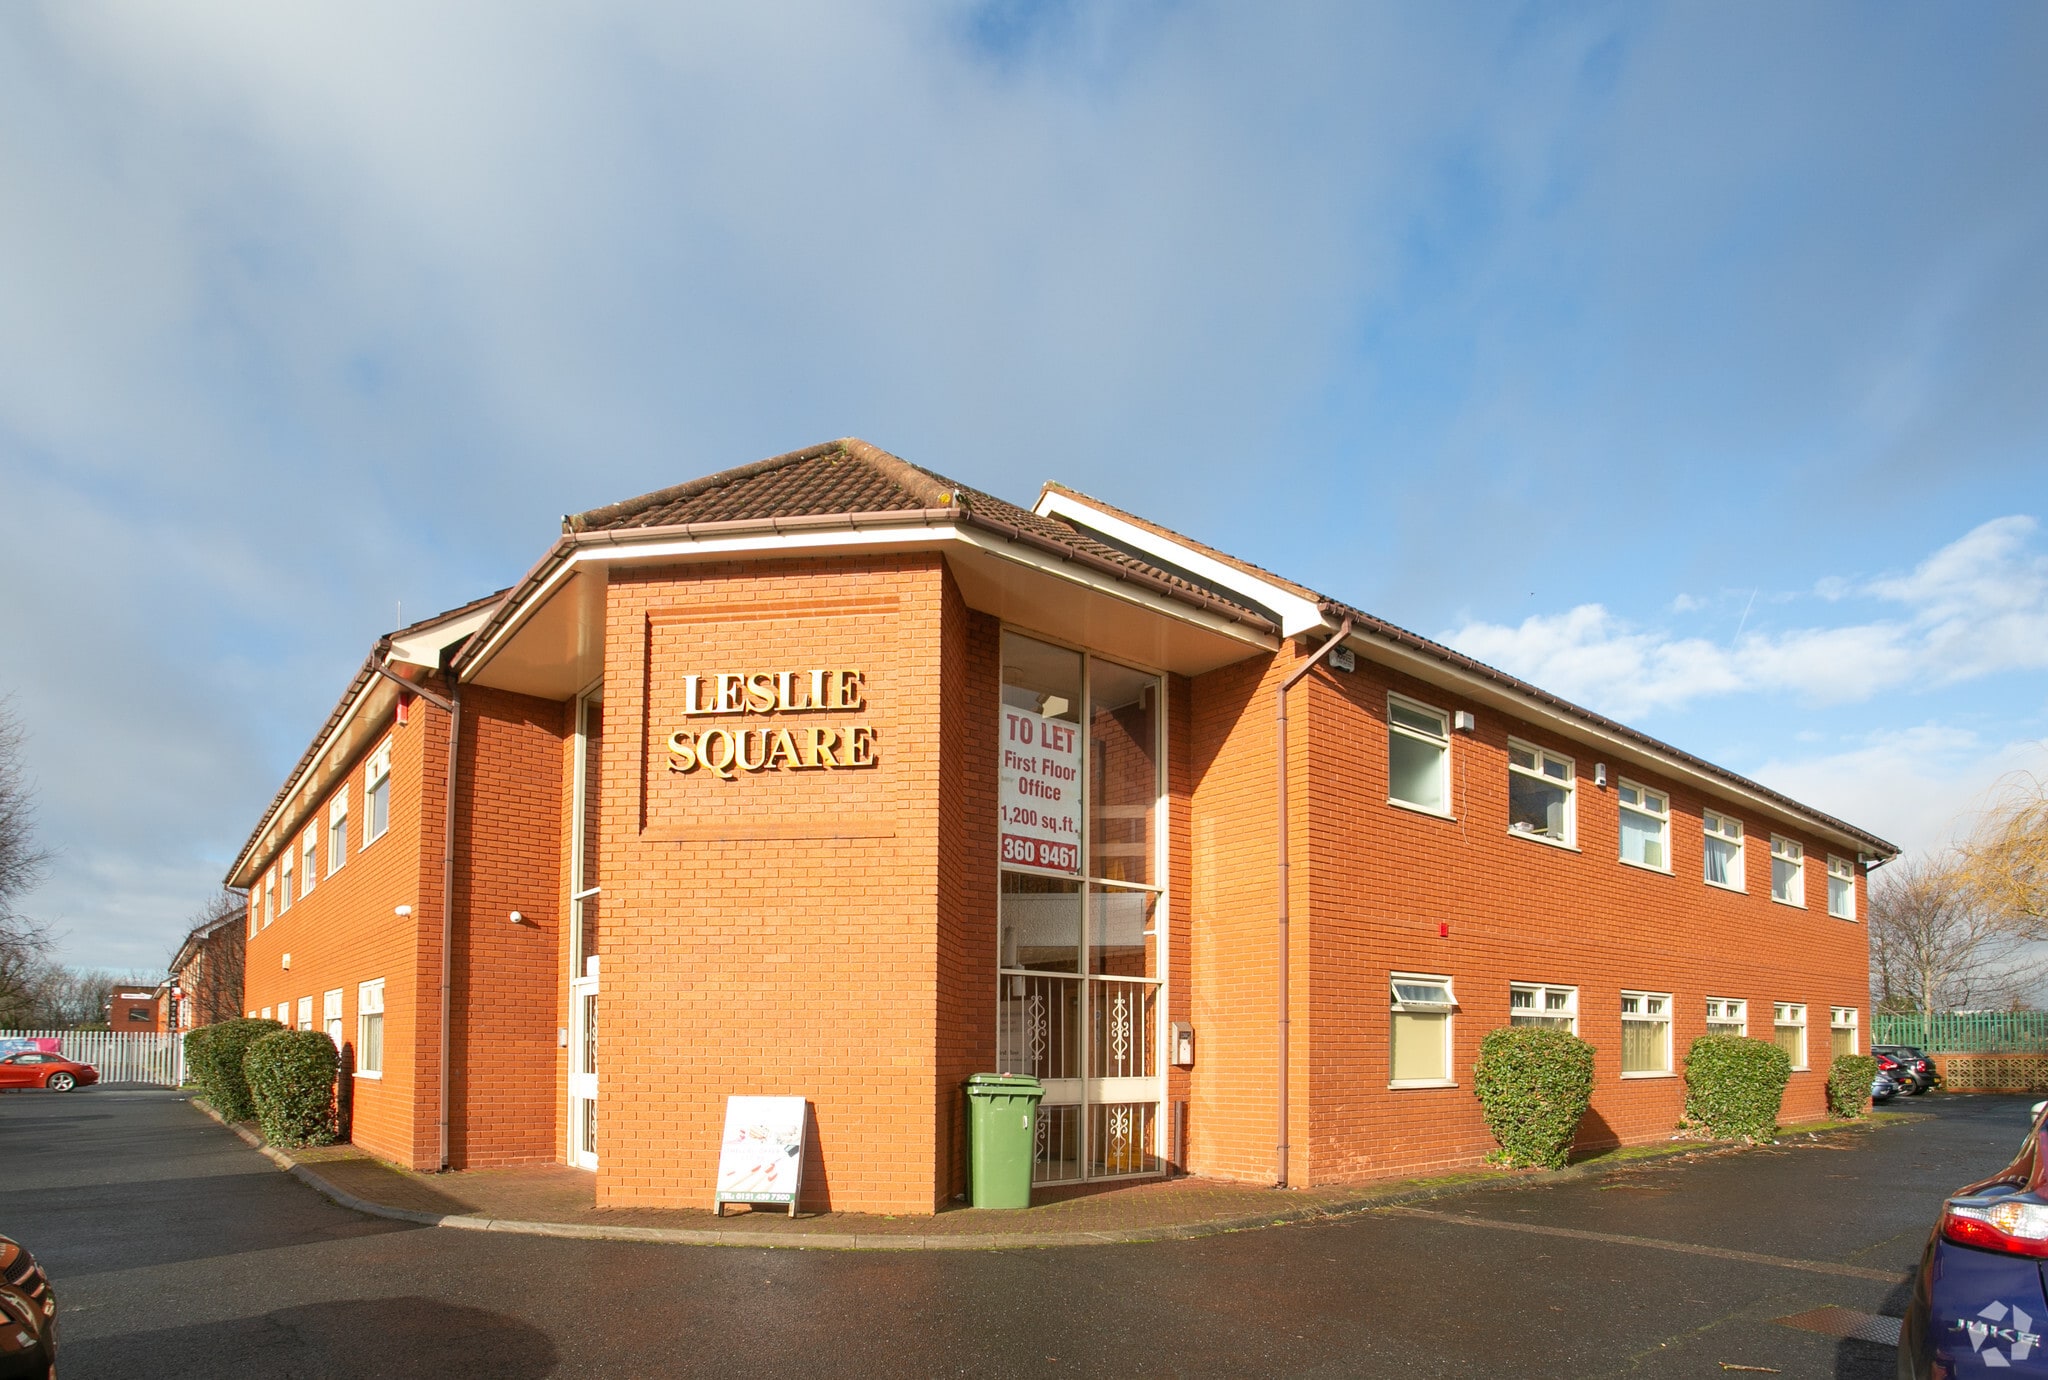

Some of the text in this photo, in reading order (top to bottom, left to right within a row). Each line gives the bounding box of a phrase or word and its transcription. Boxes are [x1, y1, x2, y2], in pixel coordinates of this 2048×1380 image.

[682, 669, 862, 716] LESLIE
[1007, 713, 1075, 754] TO LET
[667, 725, 875, 779] SQUARE
[1004, 749, 1077, 781] First Floor
[1018, 776, 1061, 801] Office
[1001, 805, 1079, 834] 1,200 sq.ft.
[1003, 838, 1076, 868] 360 9461
